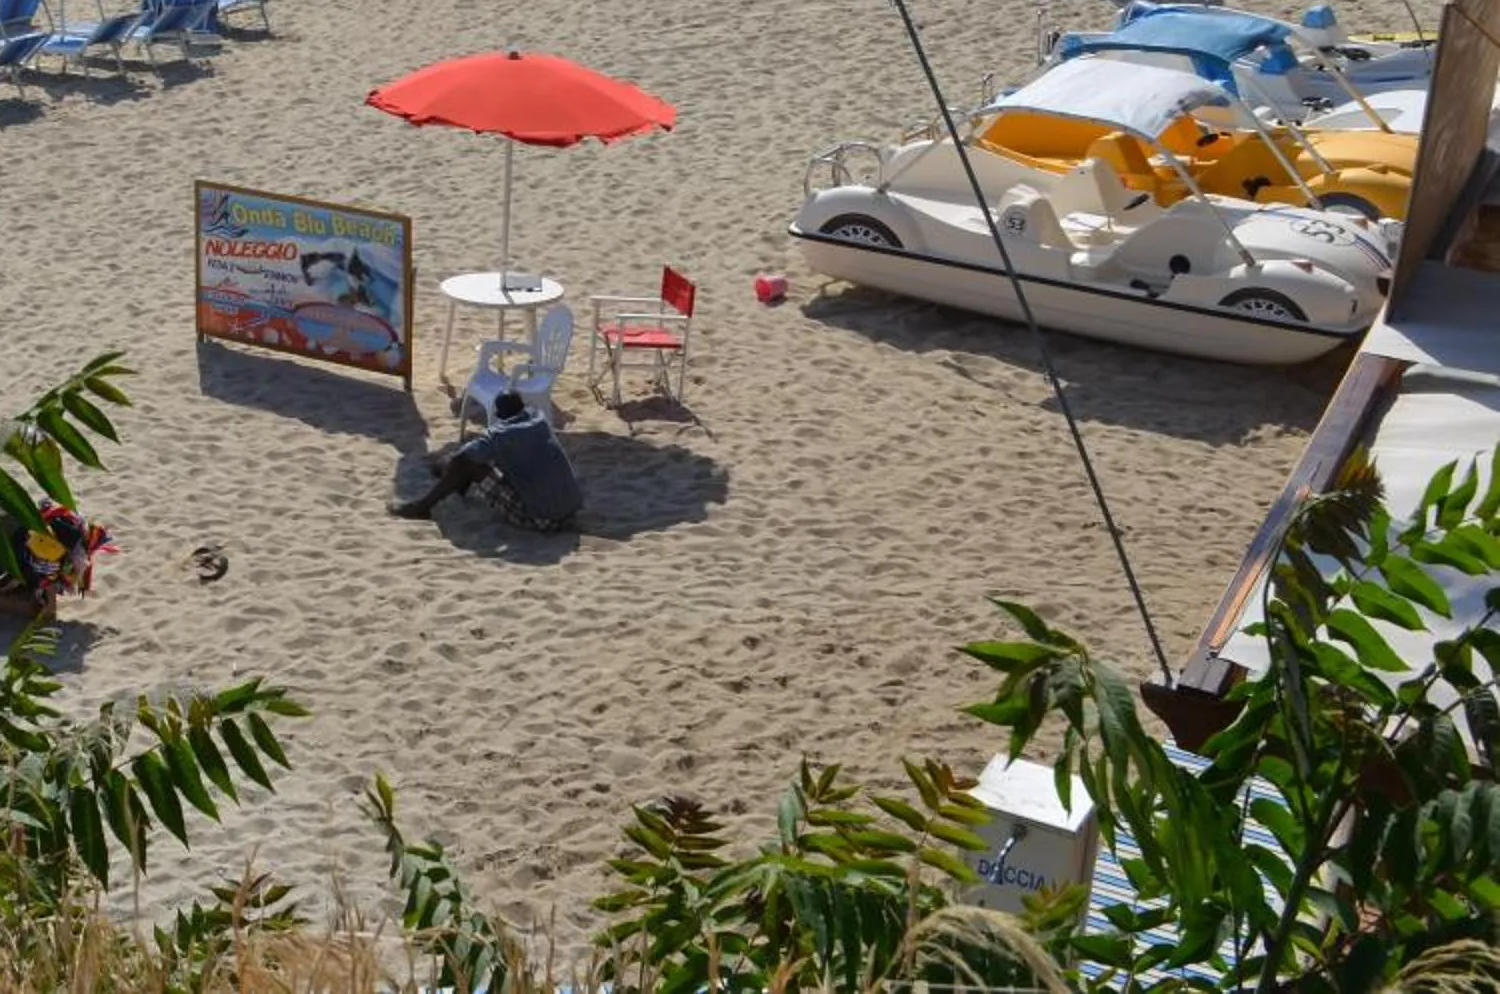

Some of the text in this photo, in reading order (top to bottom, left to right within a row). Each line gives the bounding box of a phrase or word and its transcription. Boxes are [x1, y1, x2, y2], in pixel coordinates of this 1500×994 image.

[231, 203, 396, 245] Onda Blu Beach
[1301, 219, 1346, 244] 53
[205, 238, 298, 261] NOLEGGIO
